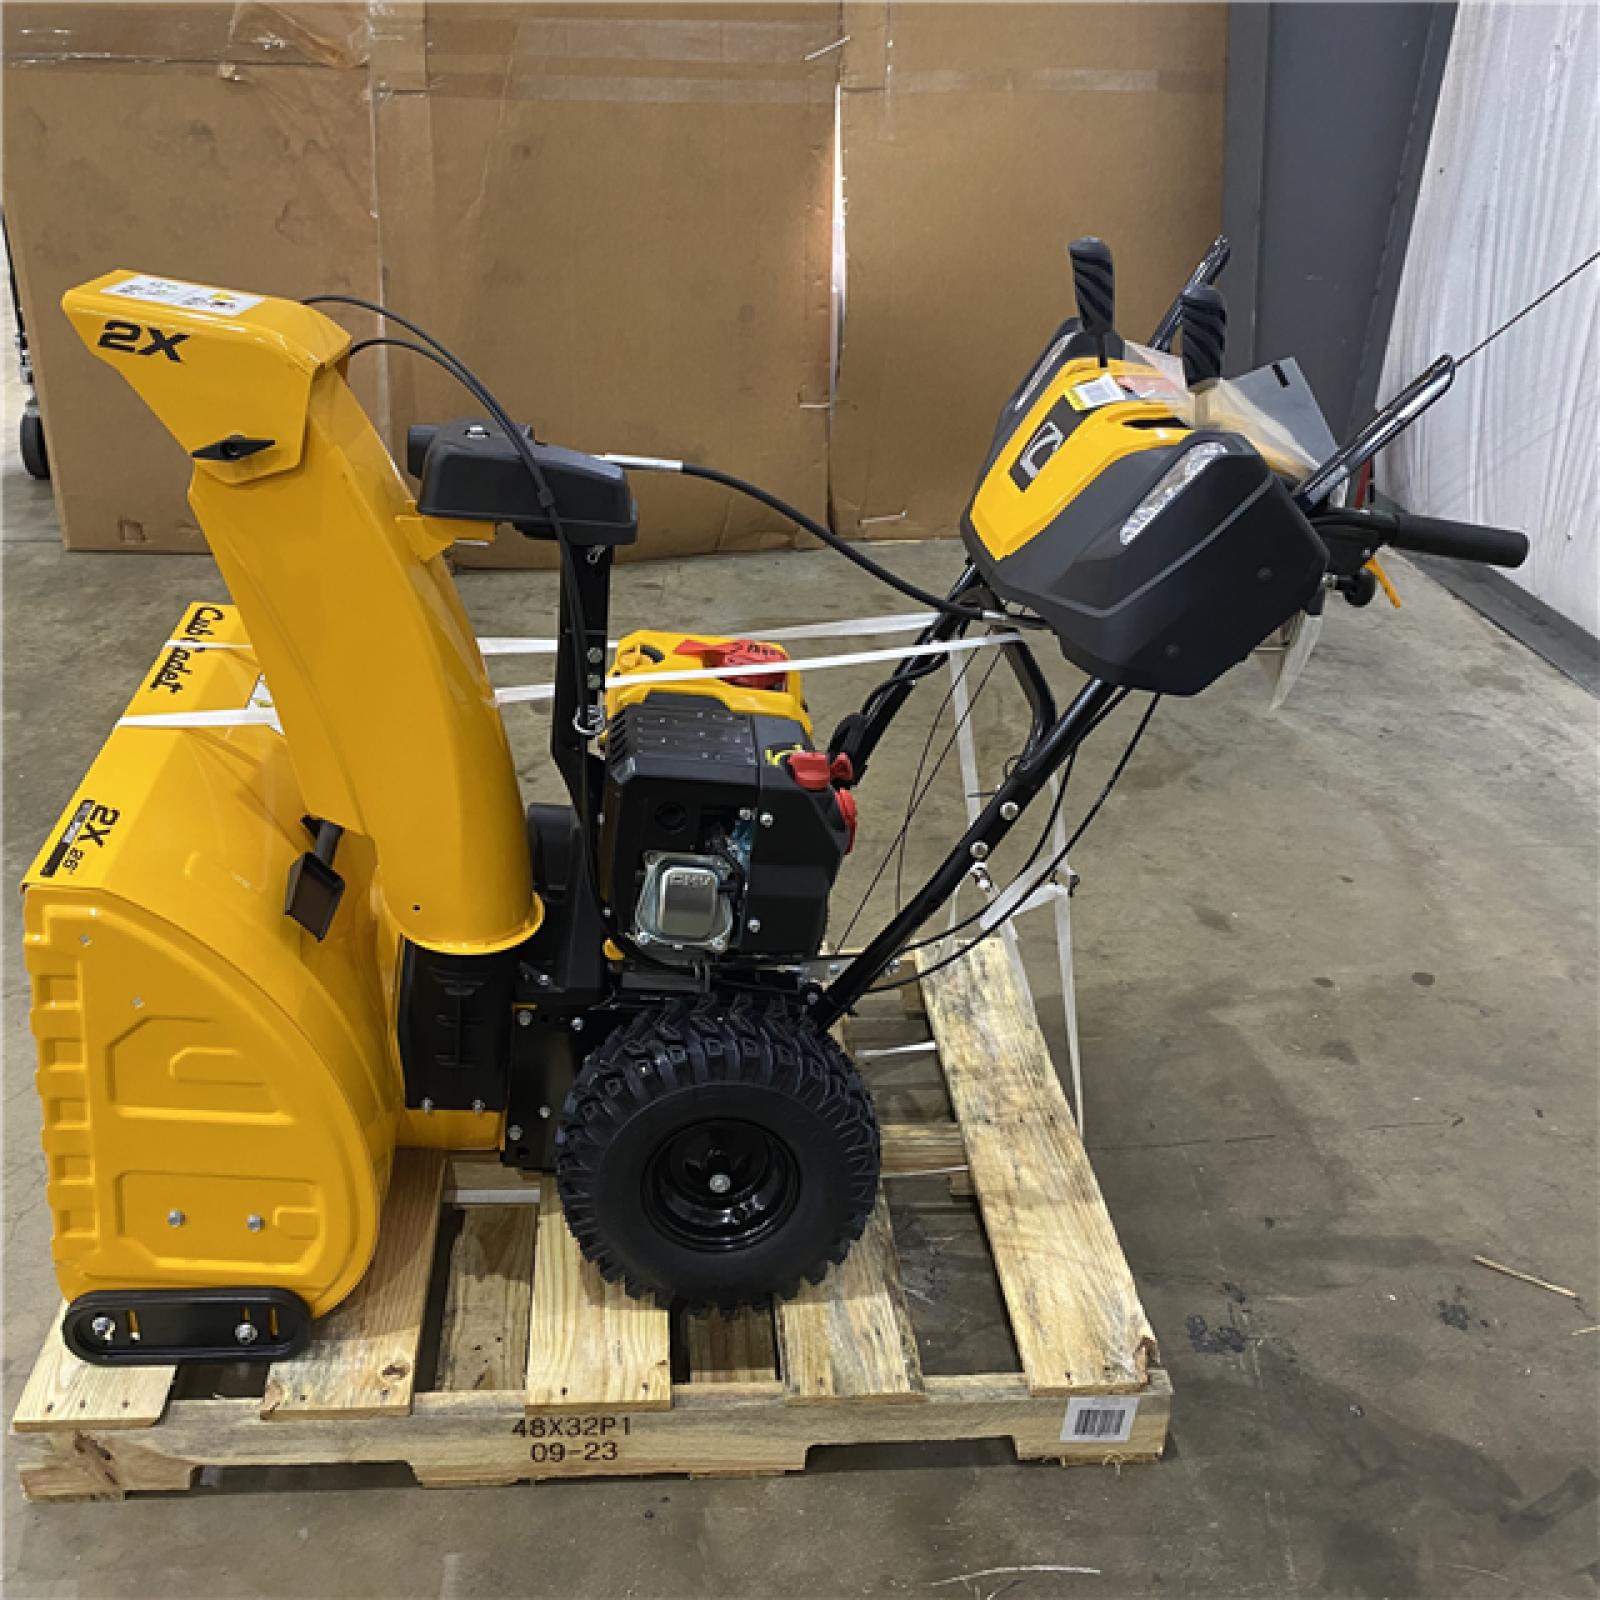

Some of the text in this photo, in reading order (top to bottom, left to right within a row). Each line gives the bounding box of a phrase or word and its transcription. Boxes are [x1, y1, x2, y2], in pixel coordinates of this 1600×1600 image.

[97, 320, 191, 362] 2X
[185, 606, 225, 636] Cub
[77, 804, 121, 848] 2X
[512, 1416, 631, 1438] 48X32P1
[530, 1440, 619, 1463] 09-23
